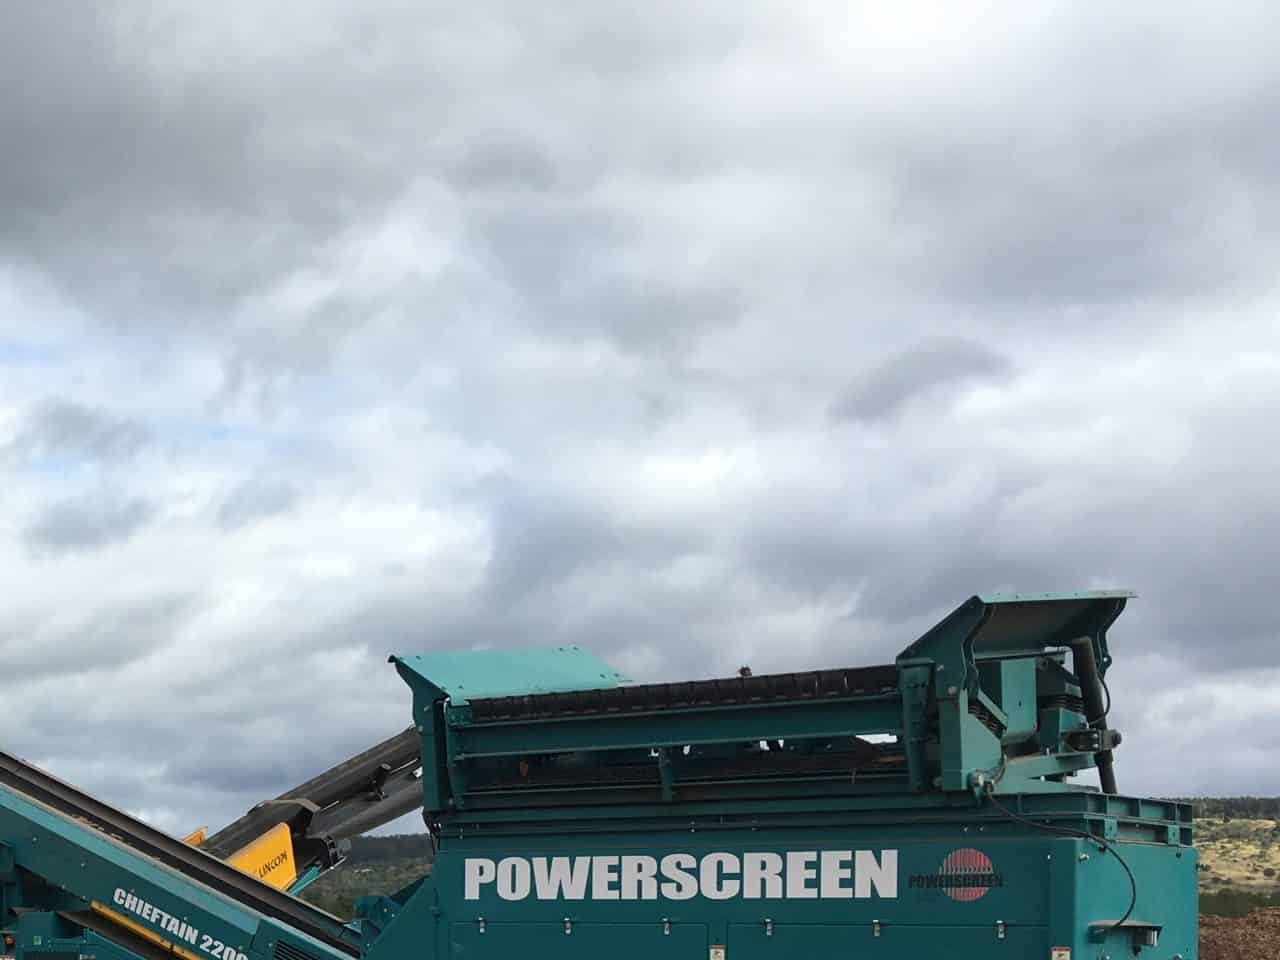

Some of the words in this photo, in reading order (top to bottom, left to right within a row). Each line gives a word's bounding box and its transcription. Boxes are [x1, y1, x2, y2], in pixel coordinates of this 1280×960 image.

[464, 849, 898, 901] POWERSCREEN
[908, 873, 1003, 889] POWERSCREEN
[113, 887, 199, 945] CHIEFTAIN
